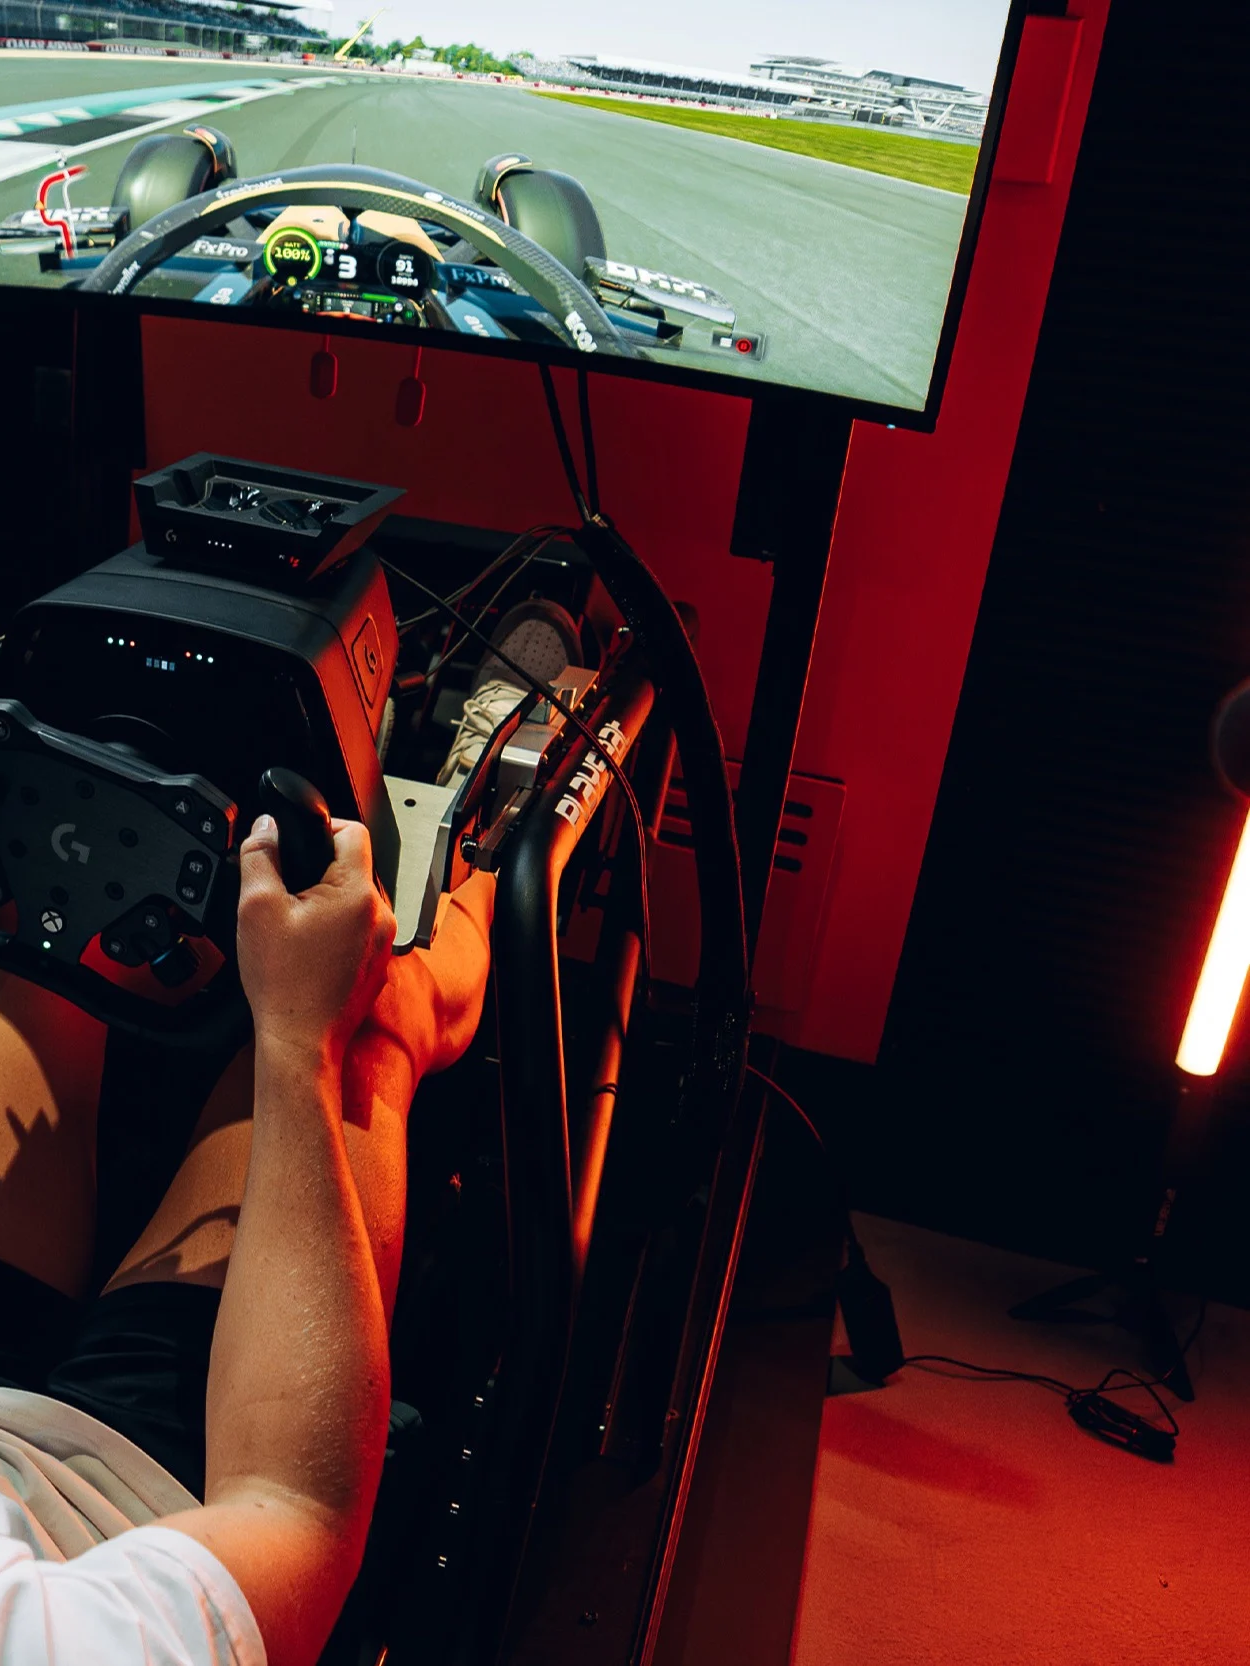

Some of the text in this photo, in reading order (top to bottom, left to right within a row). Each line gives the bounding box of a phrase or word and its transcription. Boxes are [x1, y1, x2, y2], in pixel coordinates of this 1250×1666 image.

[442, 199, 485, 221] chrome
[193, 239, 249, 258] FxPro
[274, 246, 311, 262] 100%
[338, 254, 357, 279] 3
[395, 259, 414, 273] 91
[175, 801, 186, 814] A
[202, 821, 212, 834] B
[189, 861, 203, 873] RT
